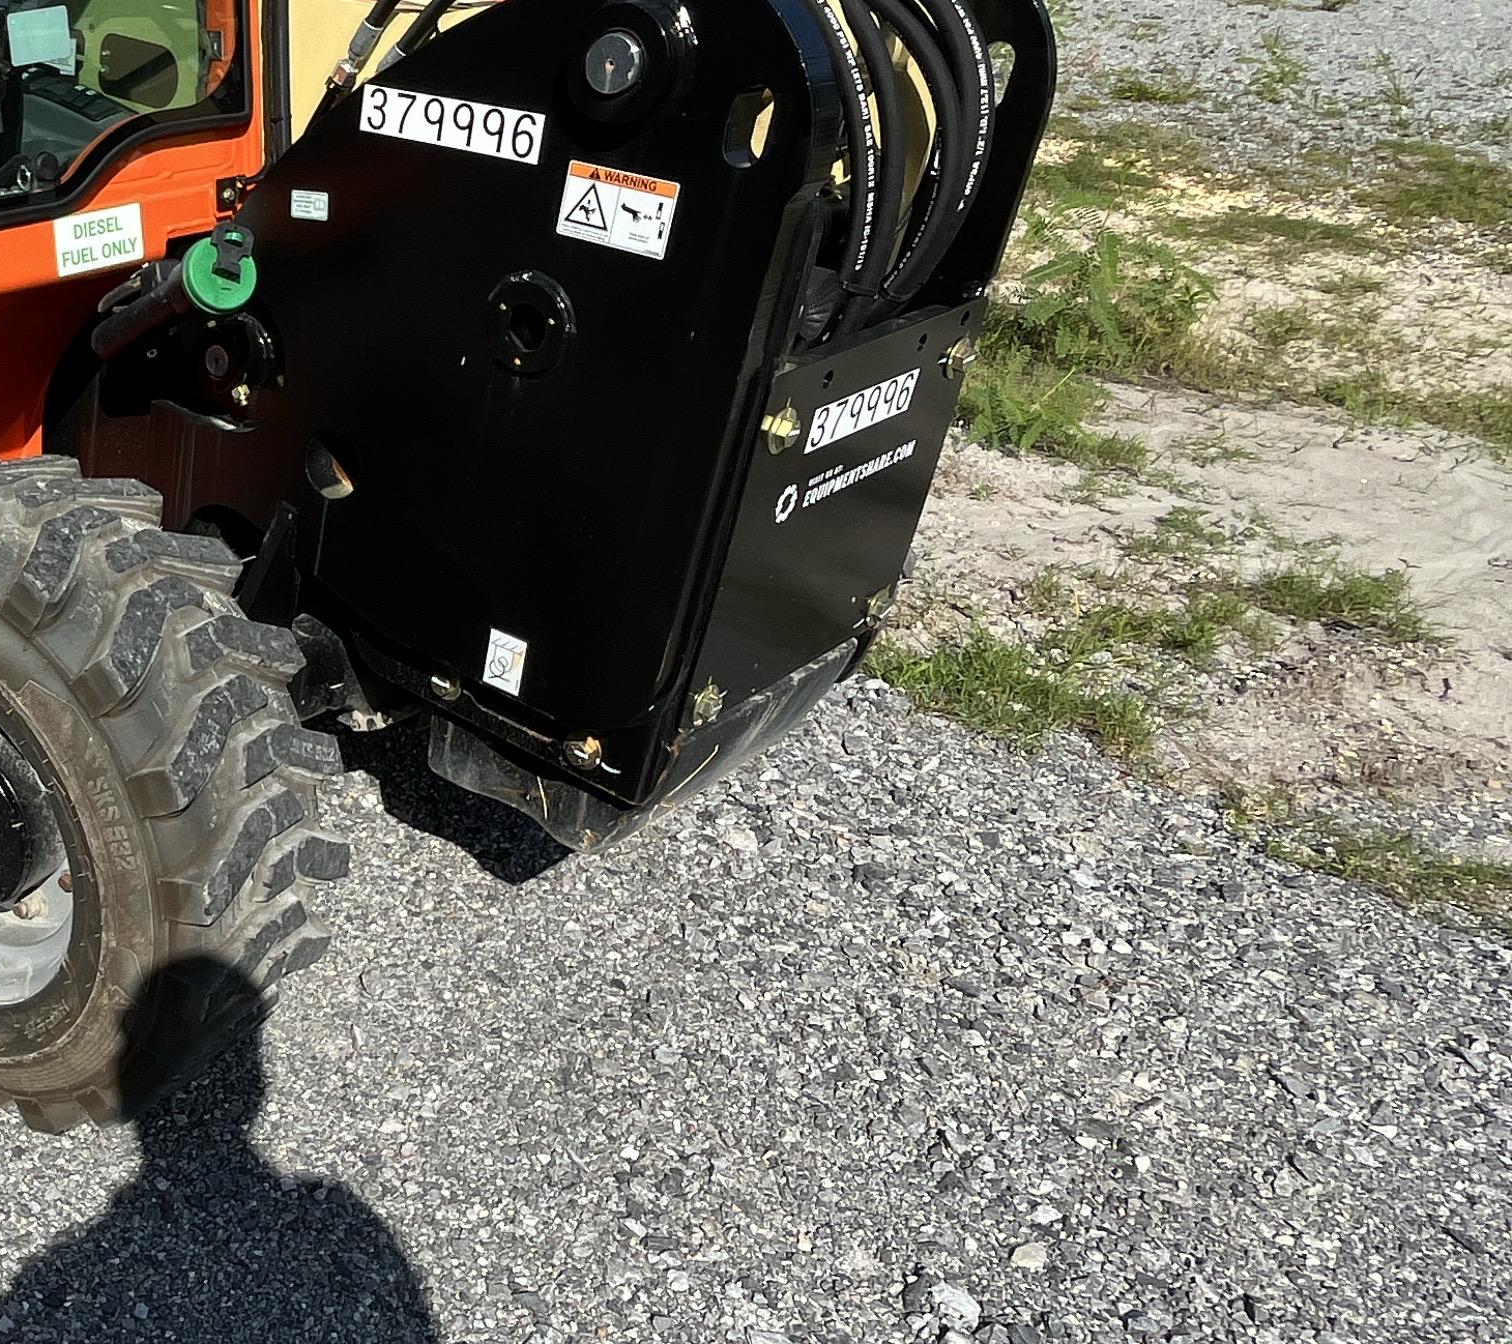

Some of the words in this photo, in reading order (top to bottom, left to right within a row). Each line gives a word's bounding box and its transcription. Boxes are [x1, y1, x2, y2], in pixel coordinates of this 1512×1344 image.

[366, 87, 538, 159] 379996
[603, 170, 658, 192] WARNING
[72, 216, 124, 240] DIESEL
[61, 248, 99, 269] FUEL
[101, 237, 138, 260] ONLY
[810, 373, 914, 448] 379996
[802, 439, 918, 508] EQUIPMENTSHARE.COM
[88, 775, 121, 822] SKS
